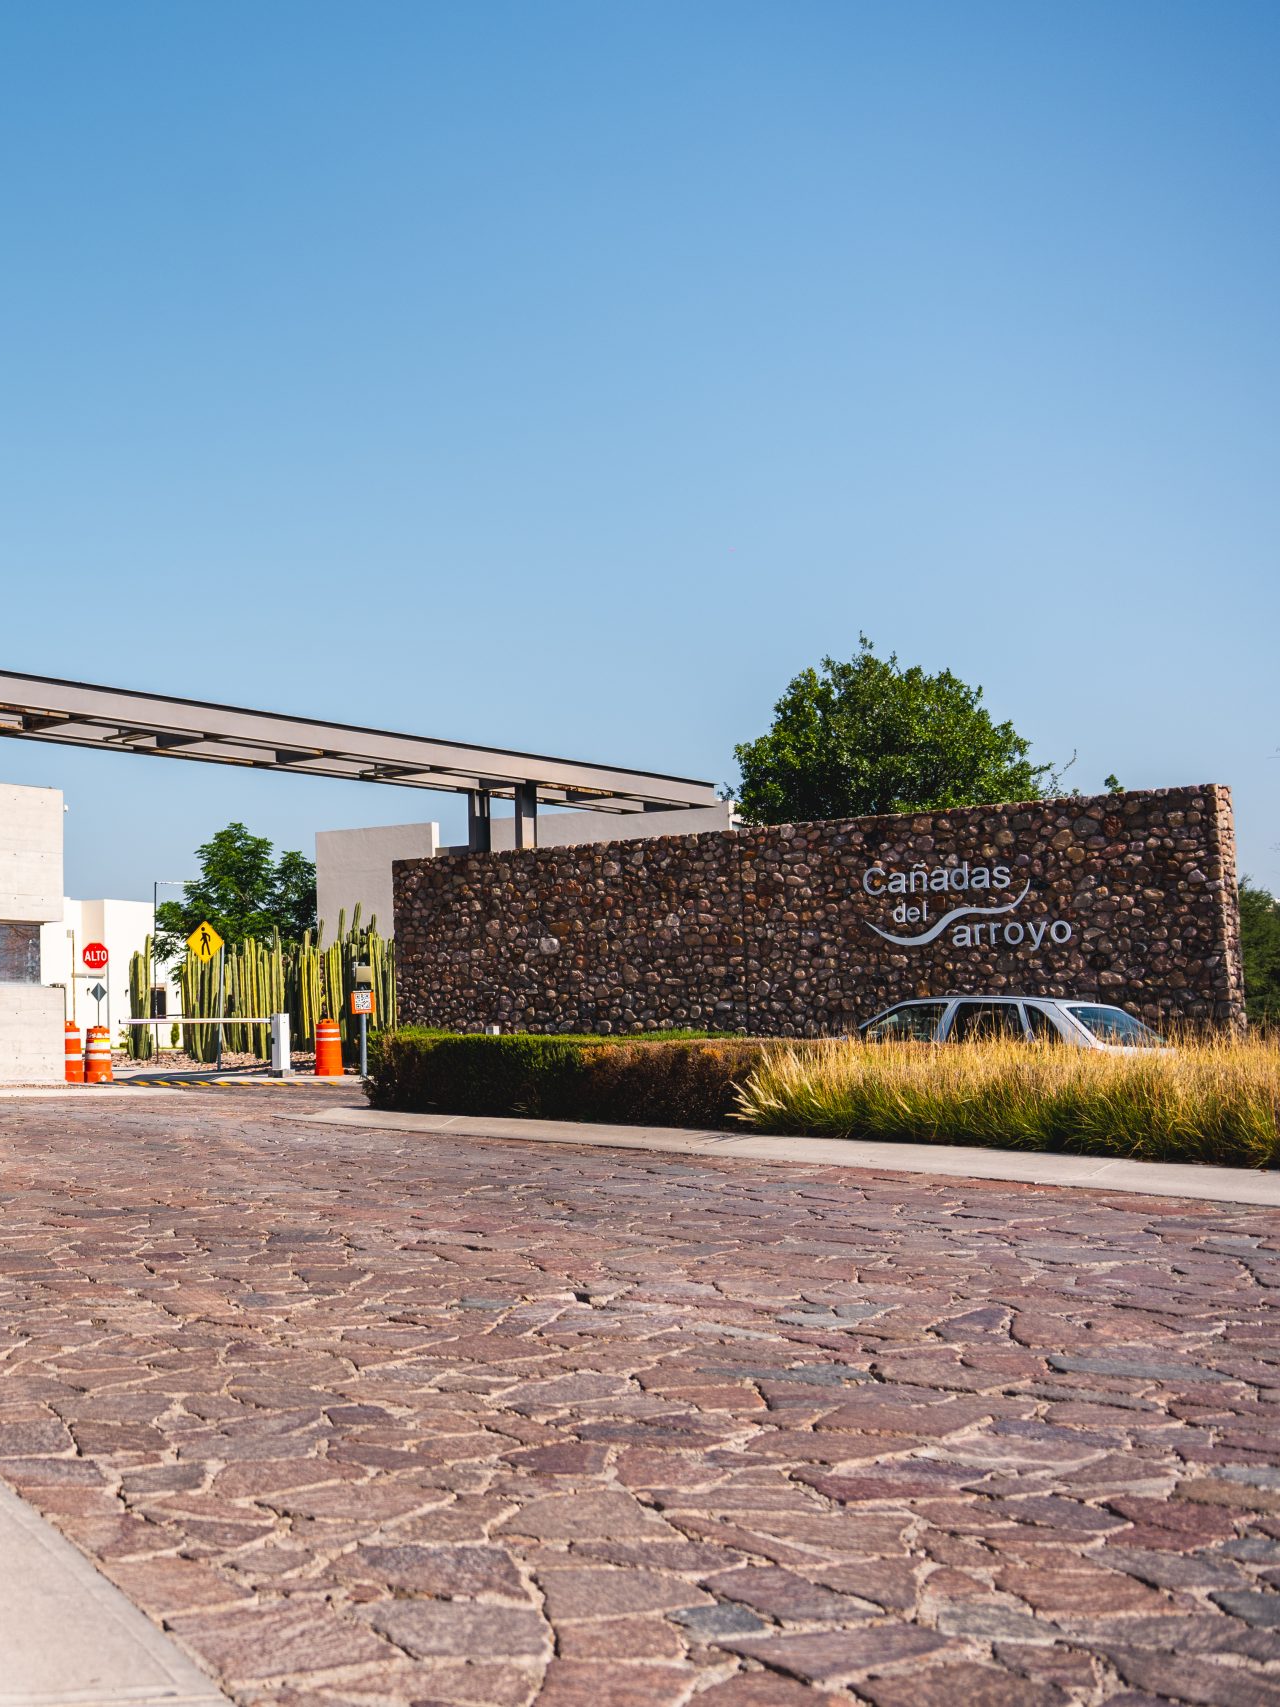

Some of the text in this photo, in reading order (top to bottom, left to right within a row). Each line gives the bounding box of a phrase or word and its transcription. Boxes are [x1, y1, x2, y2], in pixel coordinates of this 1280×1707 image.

[862, 859, 1011, 896] Cañadas
[892, 902, 927, 923] del
[952, 919, 1072, 951] arroyo
[84, 950, 107, 962] ALTO
